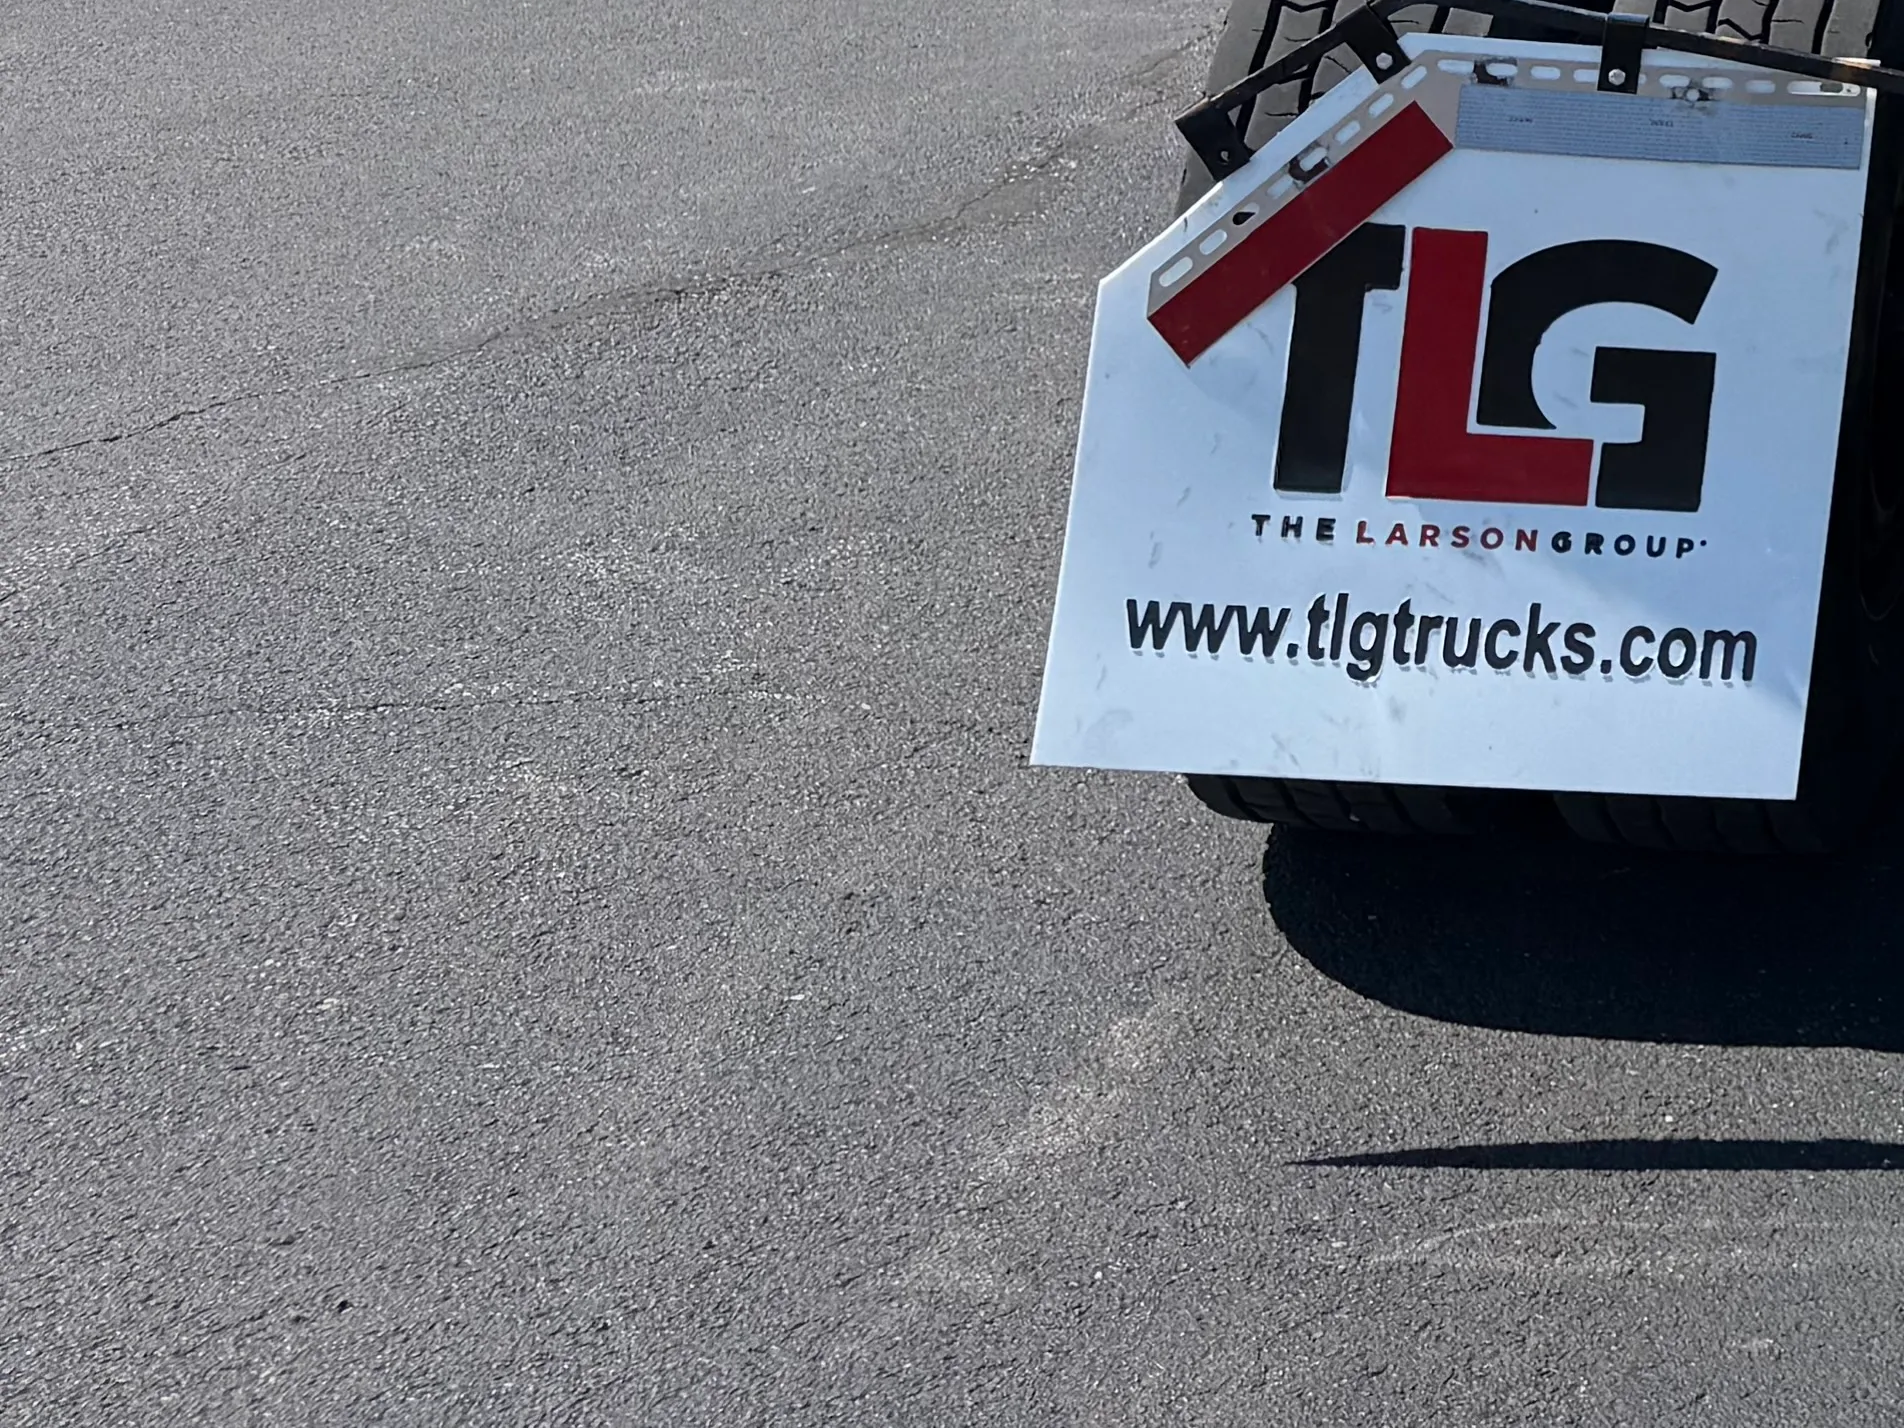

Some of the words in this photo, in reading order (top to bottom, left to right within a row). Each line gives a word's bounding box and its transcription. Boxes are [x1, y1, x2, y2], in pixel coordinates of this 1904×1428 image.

[1273, 222, 1718, 512] TLG
[1250, 513, 1337, 542] THE
[1355, 520, 1539, 552] LARSON
[1126, 593, 1758, 684] www.tlgtrucks.com
